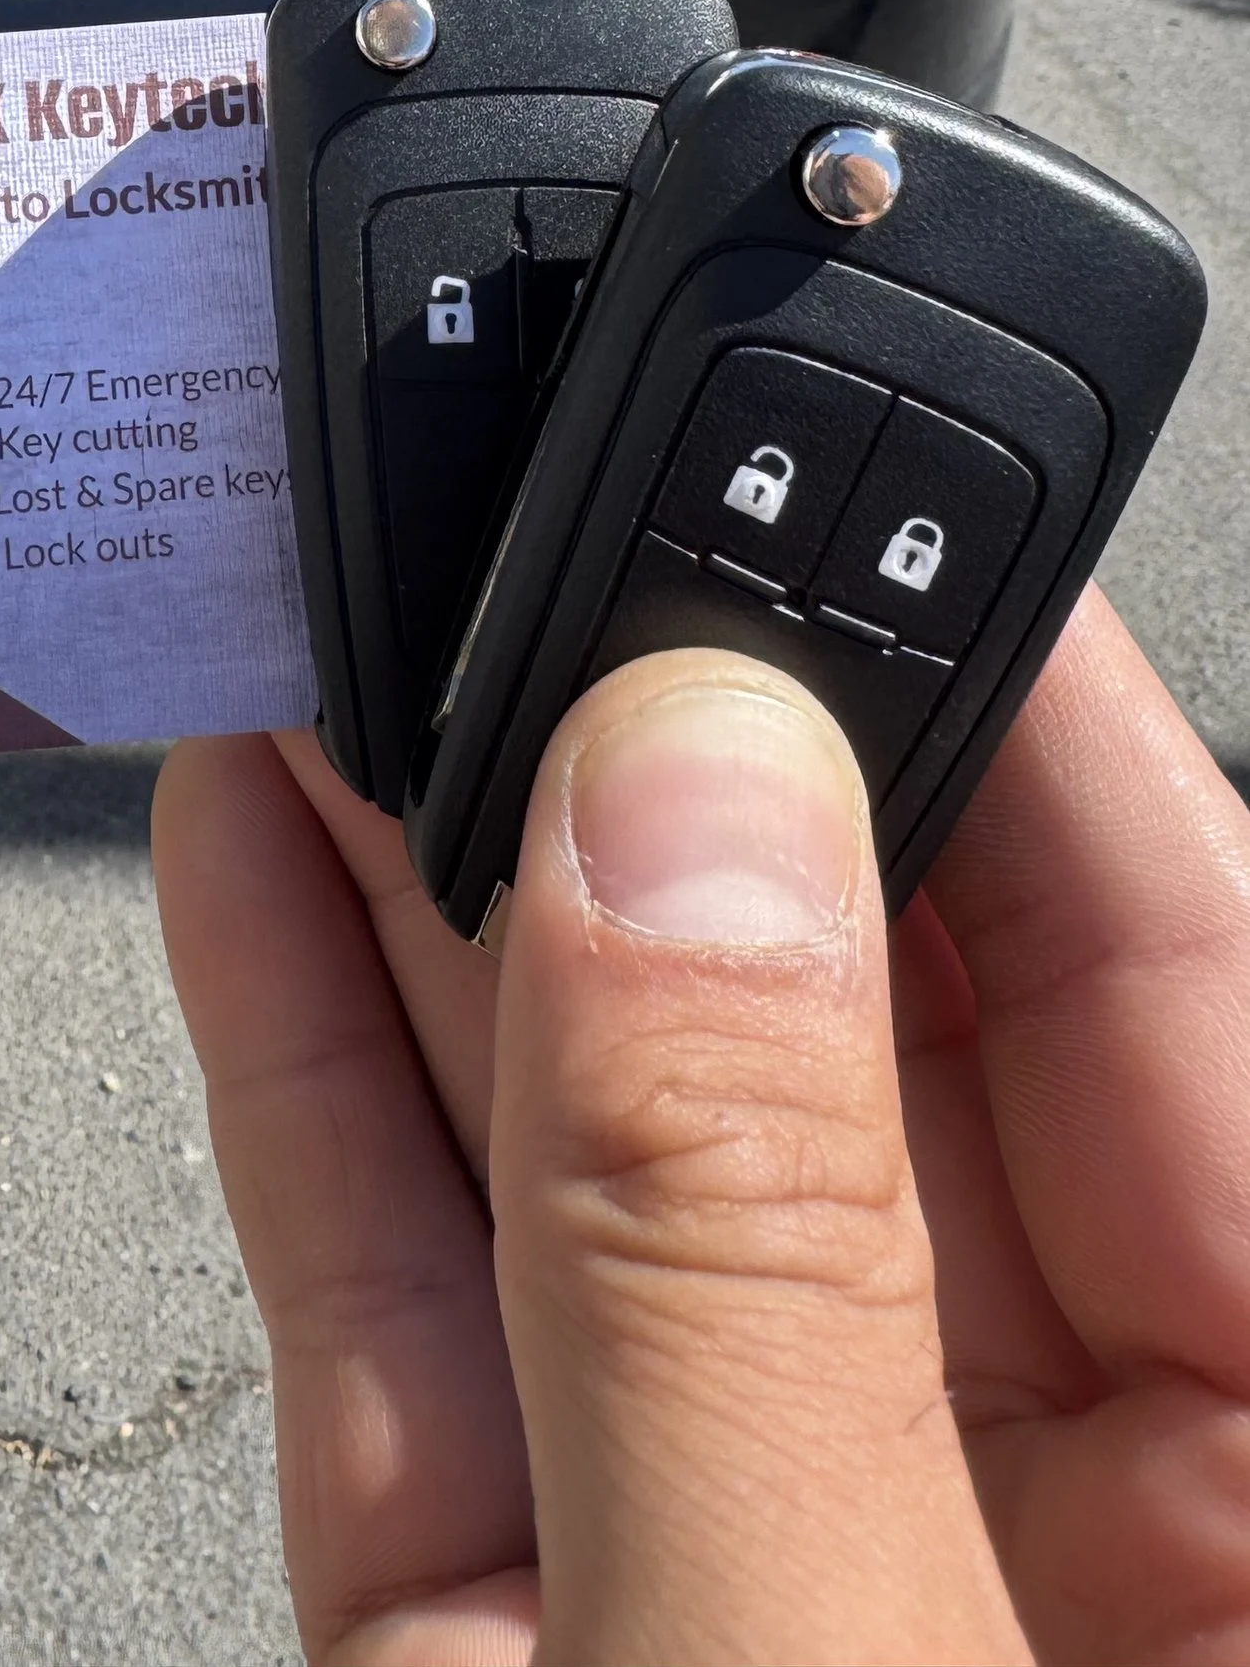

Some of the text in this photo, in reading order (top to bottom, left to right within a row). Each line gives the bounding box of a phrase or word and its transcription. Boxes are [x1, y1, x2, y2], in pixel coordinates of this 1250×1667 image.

[63, 165, 269, 220] Locksmit
[87, 364, 281, 402] Emergency
[73, 416, 198, 452] cutting
[77, 475, 104, 508] &
[114, 471, 214, 512] Spare
[4, 528, 175, 571] Lock outs
